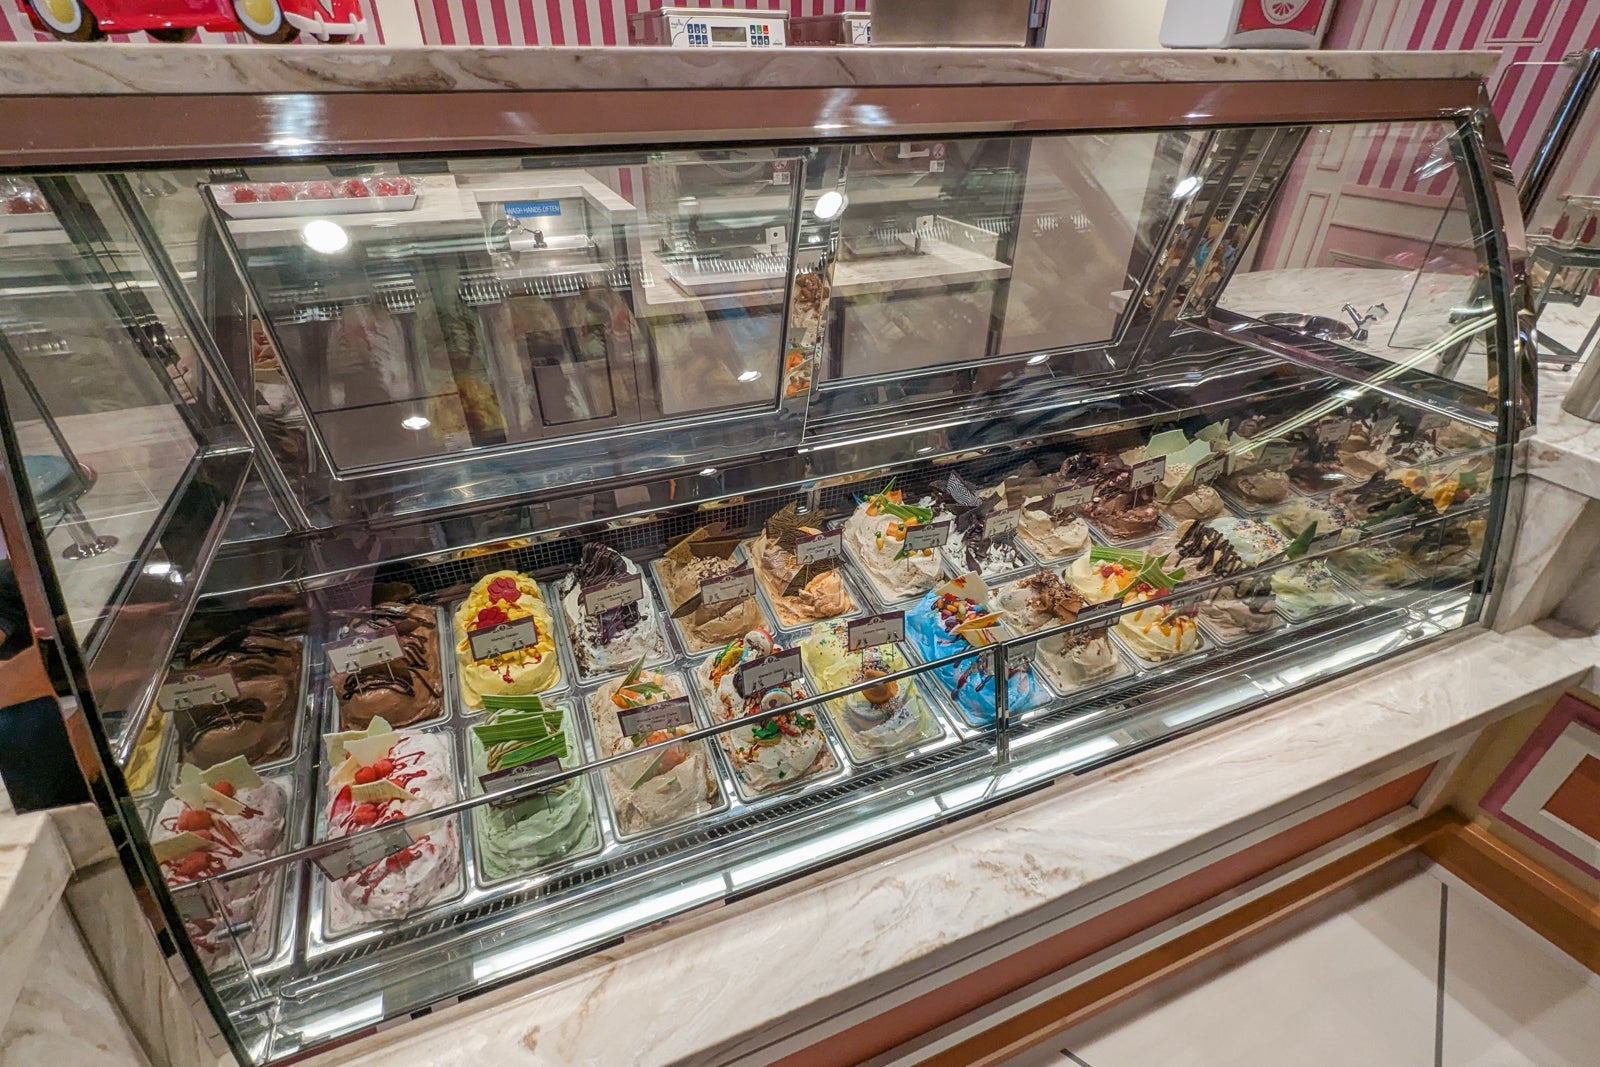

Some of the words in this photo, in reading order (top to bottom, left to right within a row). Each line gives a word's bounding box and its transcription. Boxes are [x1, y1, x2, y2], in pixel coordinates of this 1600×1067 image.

[506, 207, 523, 215] WASH
[524, 206, 542, 214] HANDS
[543, 205, 560, 213] OFTEN
